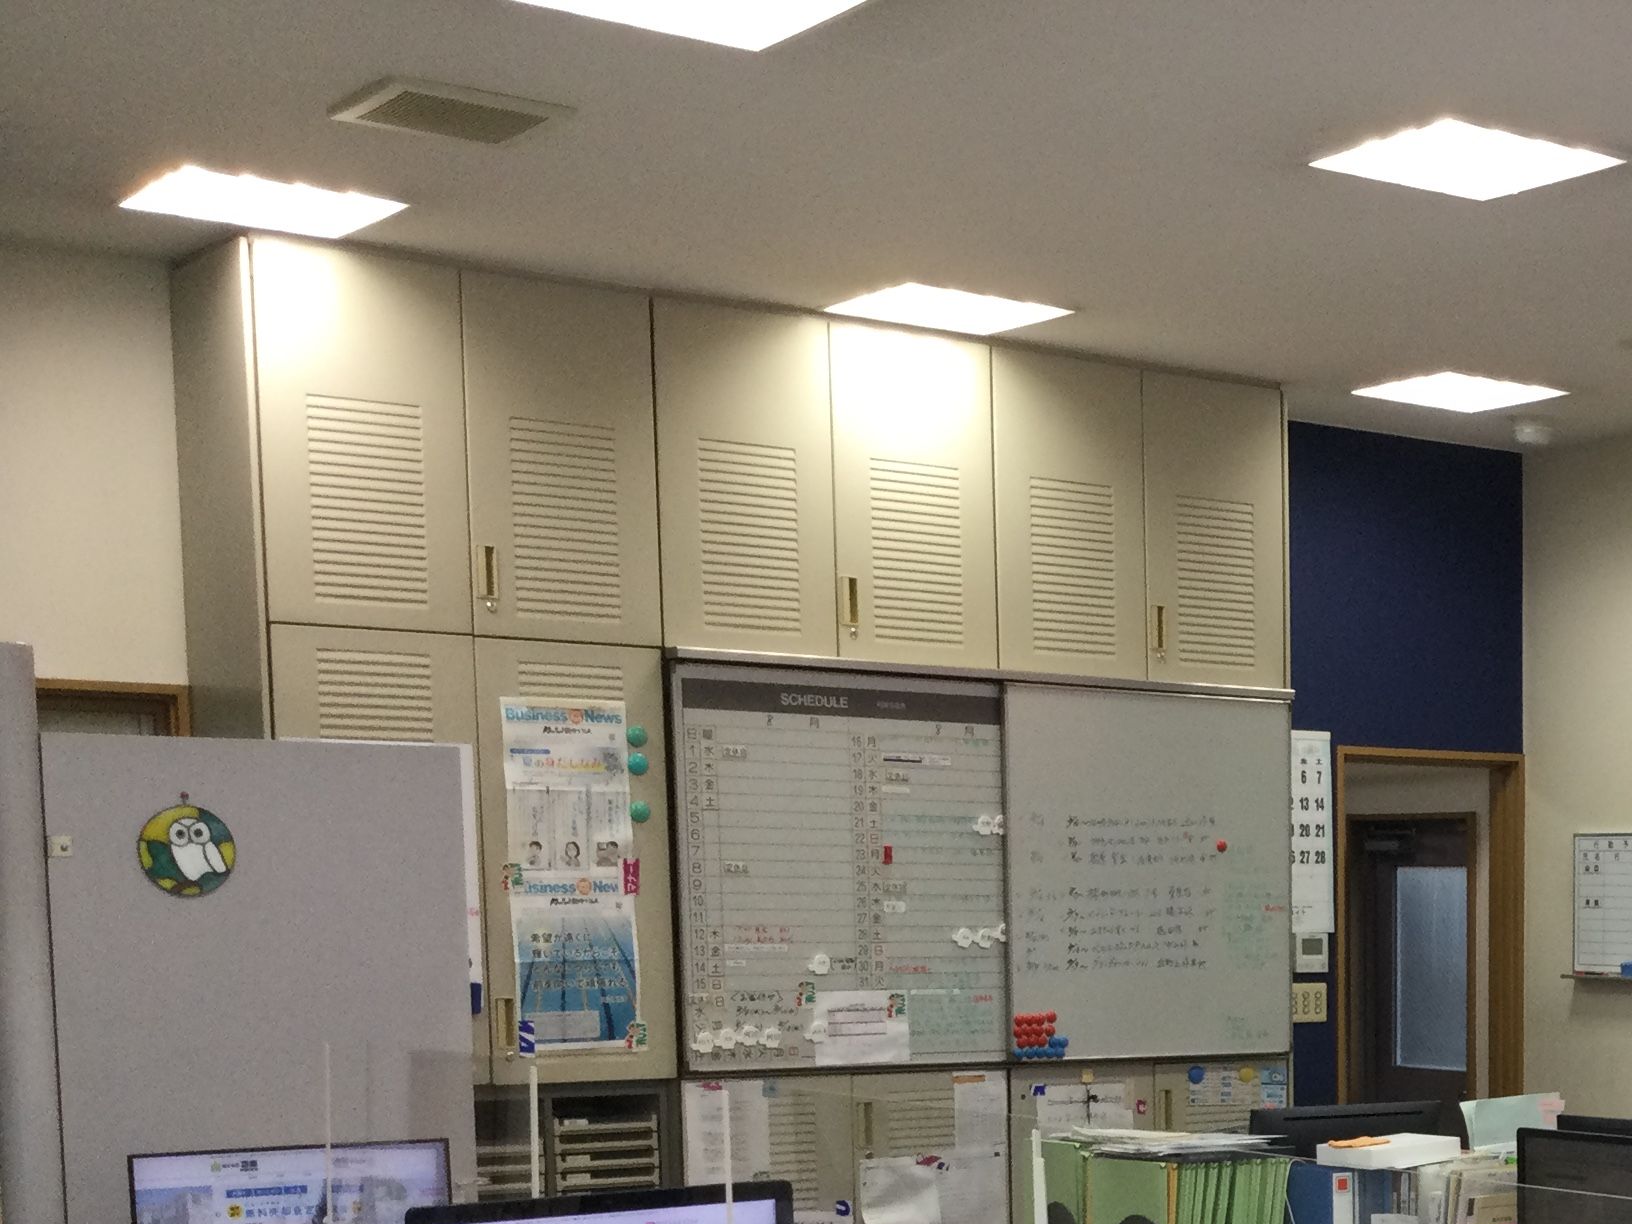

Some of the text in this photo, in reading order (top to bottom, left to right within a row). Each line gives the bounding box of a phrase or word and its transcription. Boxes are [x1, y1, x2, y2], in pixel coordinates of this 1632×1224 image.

[780, 692, 849, 708] SCHEDULE
[505, 707, 622, 724] Business News
[852, 736, 861, 747] 16
[853, 753, 862, 763] 17
[688, 762, 698, 774] 2
[853, 769, 863, 779] 18
[1301, 771, 1322, 784] 6 7
[689, 778, 699, 790] 3
[853, 784, 864, 794] 19
[689, 795, 699, 807] 4
[854, 801, 864, 812] 20
[1299, 796, 1324, 812] 13 14
[690, 812, 700, 824] 5
[854, 817, 864, 827] 21
[690, 828, 700, 840] 6
[1299, 823, 1325, 838] 20 21
[854, 834, 865, 844] 22
[691, 845, 700, 856] 7
[855, 849, 866, 859] 23
[1300, 851, 1310, 865] 27
[1315, 851, 1326, 865] 28
[692, 863, 702, 874] 8
[855, 865, 866, 876] 24
[693, 878, 702, 890] 9
[856, 881, 867, 891] 25
[693, 895, 703, 906] 10
[693, 911, 704, 923] 11
[856, 913, 868, 923] 27
[694, 929, 705, 941] 12
[694, 945, 705, 956] 13
[695, 962, 706, 973] 14
[858, 961, 869, 971] 30
[695, 978, 706, 990] 15
[859, 976, 869, 986] 31
